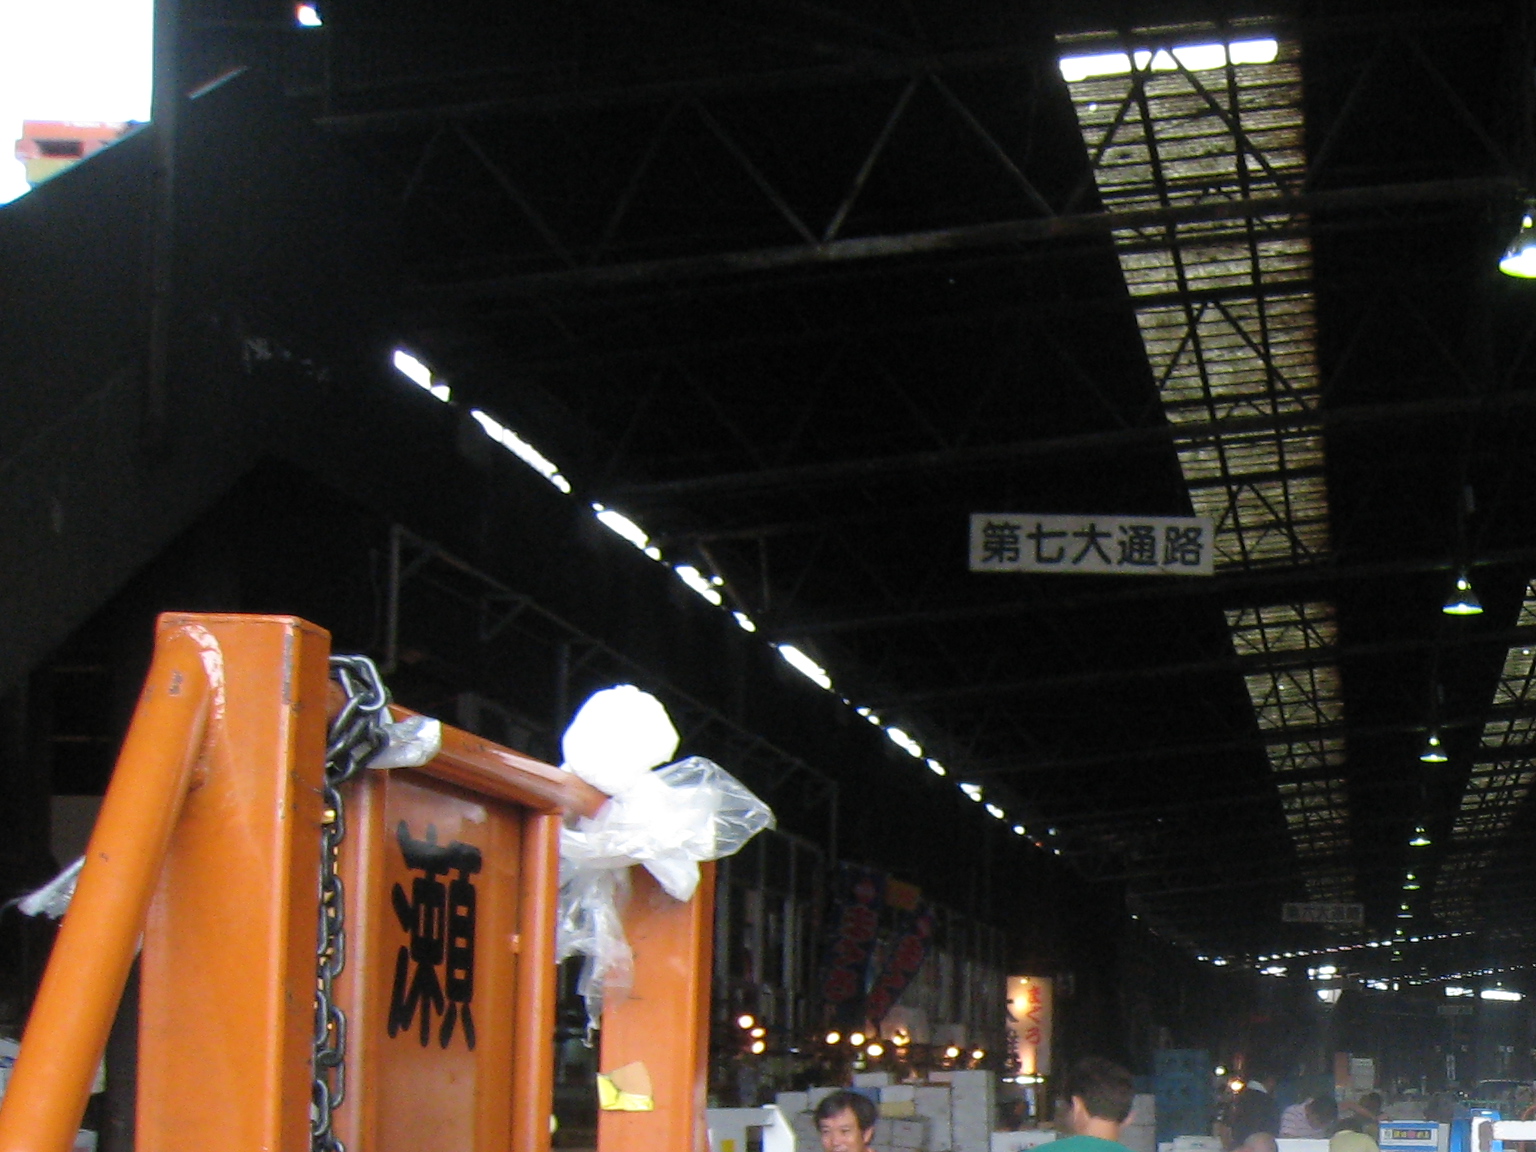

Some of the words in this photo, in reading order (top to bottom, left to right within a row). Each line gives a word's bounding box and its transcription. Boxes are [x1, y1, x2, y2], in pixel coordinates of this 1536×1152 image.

[981, 521, 1206, 568] 第七大通路
